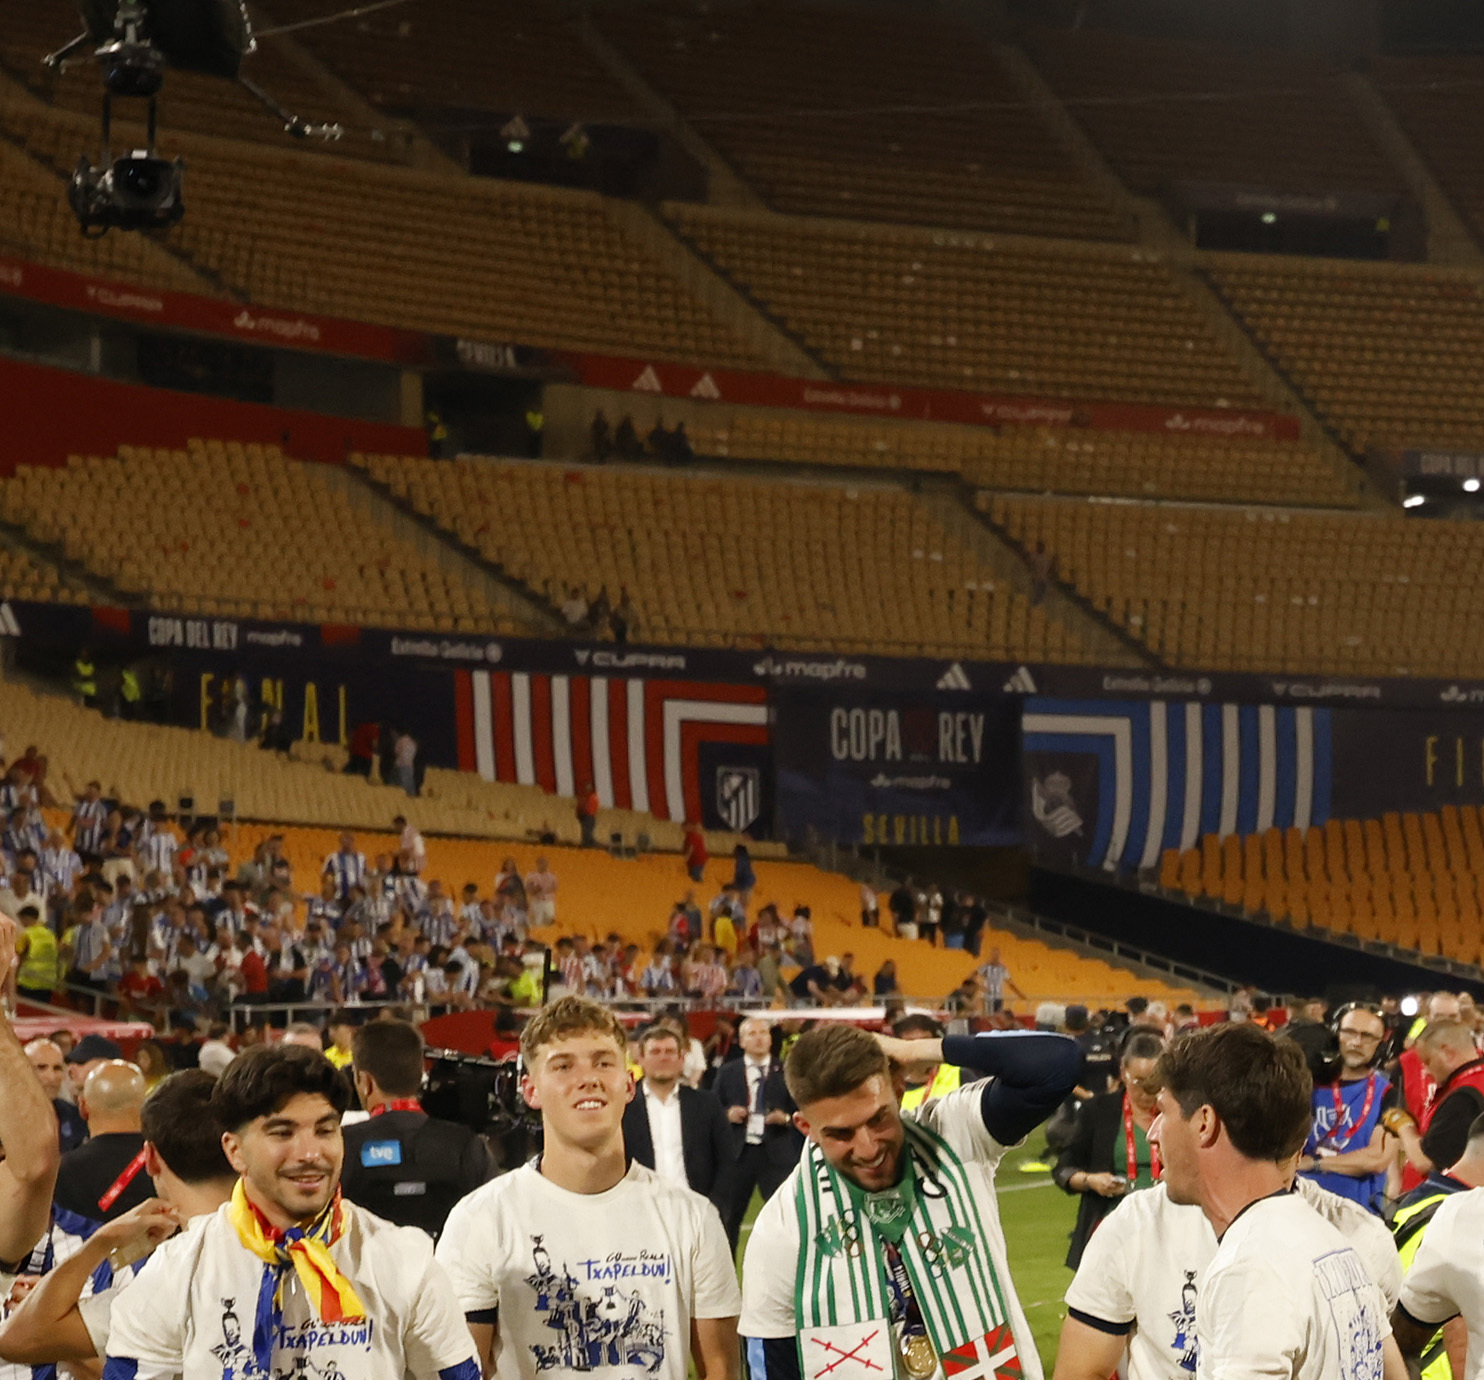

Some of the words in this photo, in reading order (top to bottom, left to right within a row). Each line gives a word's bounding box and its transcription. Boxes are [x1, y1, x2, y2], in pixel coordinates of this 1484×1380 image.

[785, 658, 867, 681] mapfre
[831, 707, 902, 762] COPA
[939, 711, 985, 764] REY
[862, 813, 961, 846] SEVILLA
